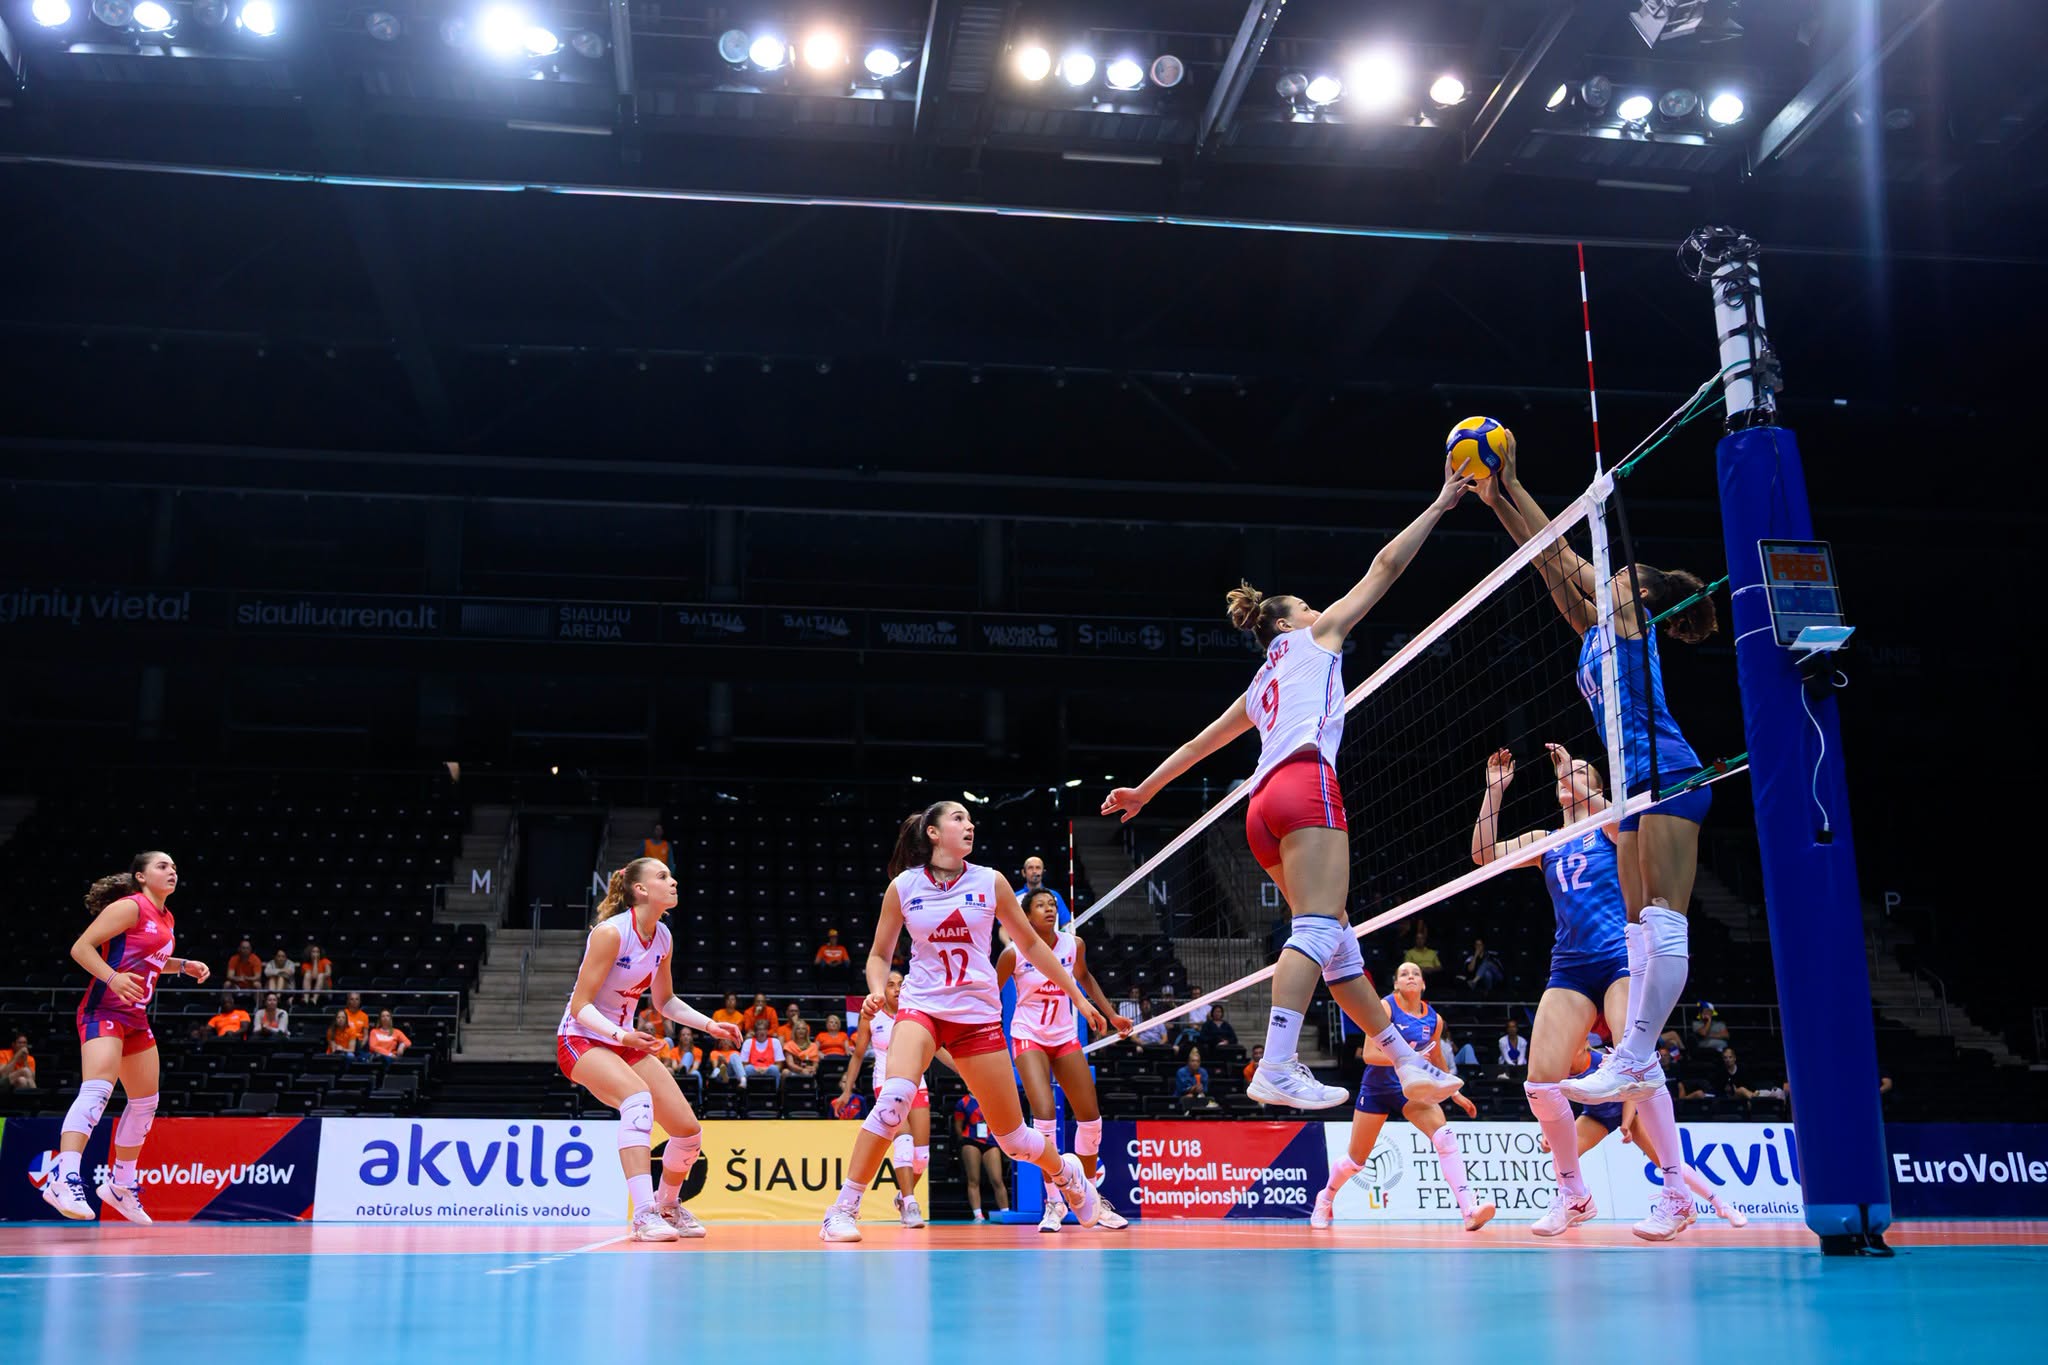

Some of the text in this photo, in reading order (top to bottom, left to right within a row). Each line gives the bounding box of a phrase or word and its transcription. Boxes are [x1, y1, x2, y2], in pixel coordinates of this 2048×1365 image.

[90, 590, 191, 621] vieta!
[238, 600, 438, 629] siauliuarena.lt
[559, 624, 623, 640] ARENA
[1261, 678, 1279, 732] 9
[471, 869, 491, 894] M
[592, 871, 613, 896] N
[1555, 853, 1592, 893] 12
[1148, 880, 1167, 905] N
[1884, 891, 1902, 916] P
[933, 926, 969, 939] MAIF
[938, 948, 973, 987] 12
[358, 1123, 594, 1188] akvilė
[1126, 1139, 1203, 1158] CEV U18
[1410, 1133, 1545, 1155] LITUVOS
[92, 1163, 295, 1190] #roVolleyU18W
[725, 1148, 901, 1192] ŠIAULA
[1127, 1162, 1308, 1185] Volleyball European
[1413, 1160, 1557, 1182] TIKLINI
[1892, 1151, 2048, 1183] EuroVolle
[356, 1202, 591, 1217] natūralus mineralinis vanduo
[1129, 1186, 1308, 1209] Championship 2026
[1732, 1201, 1800, 1215] ineralinis
